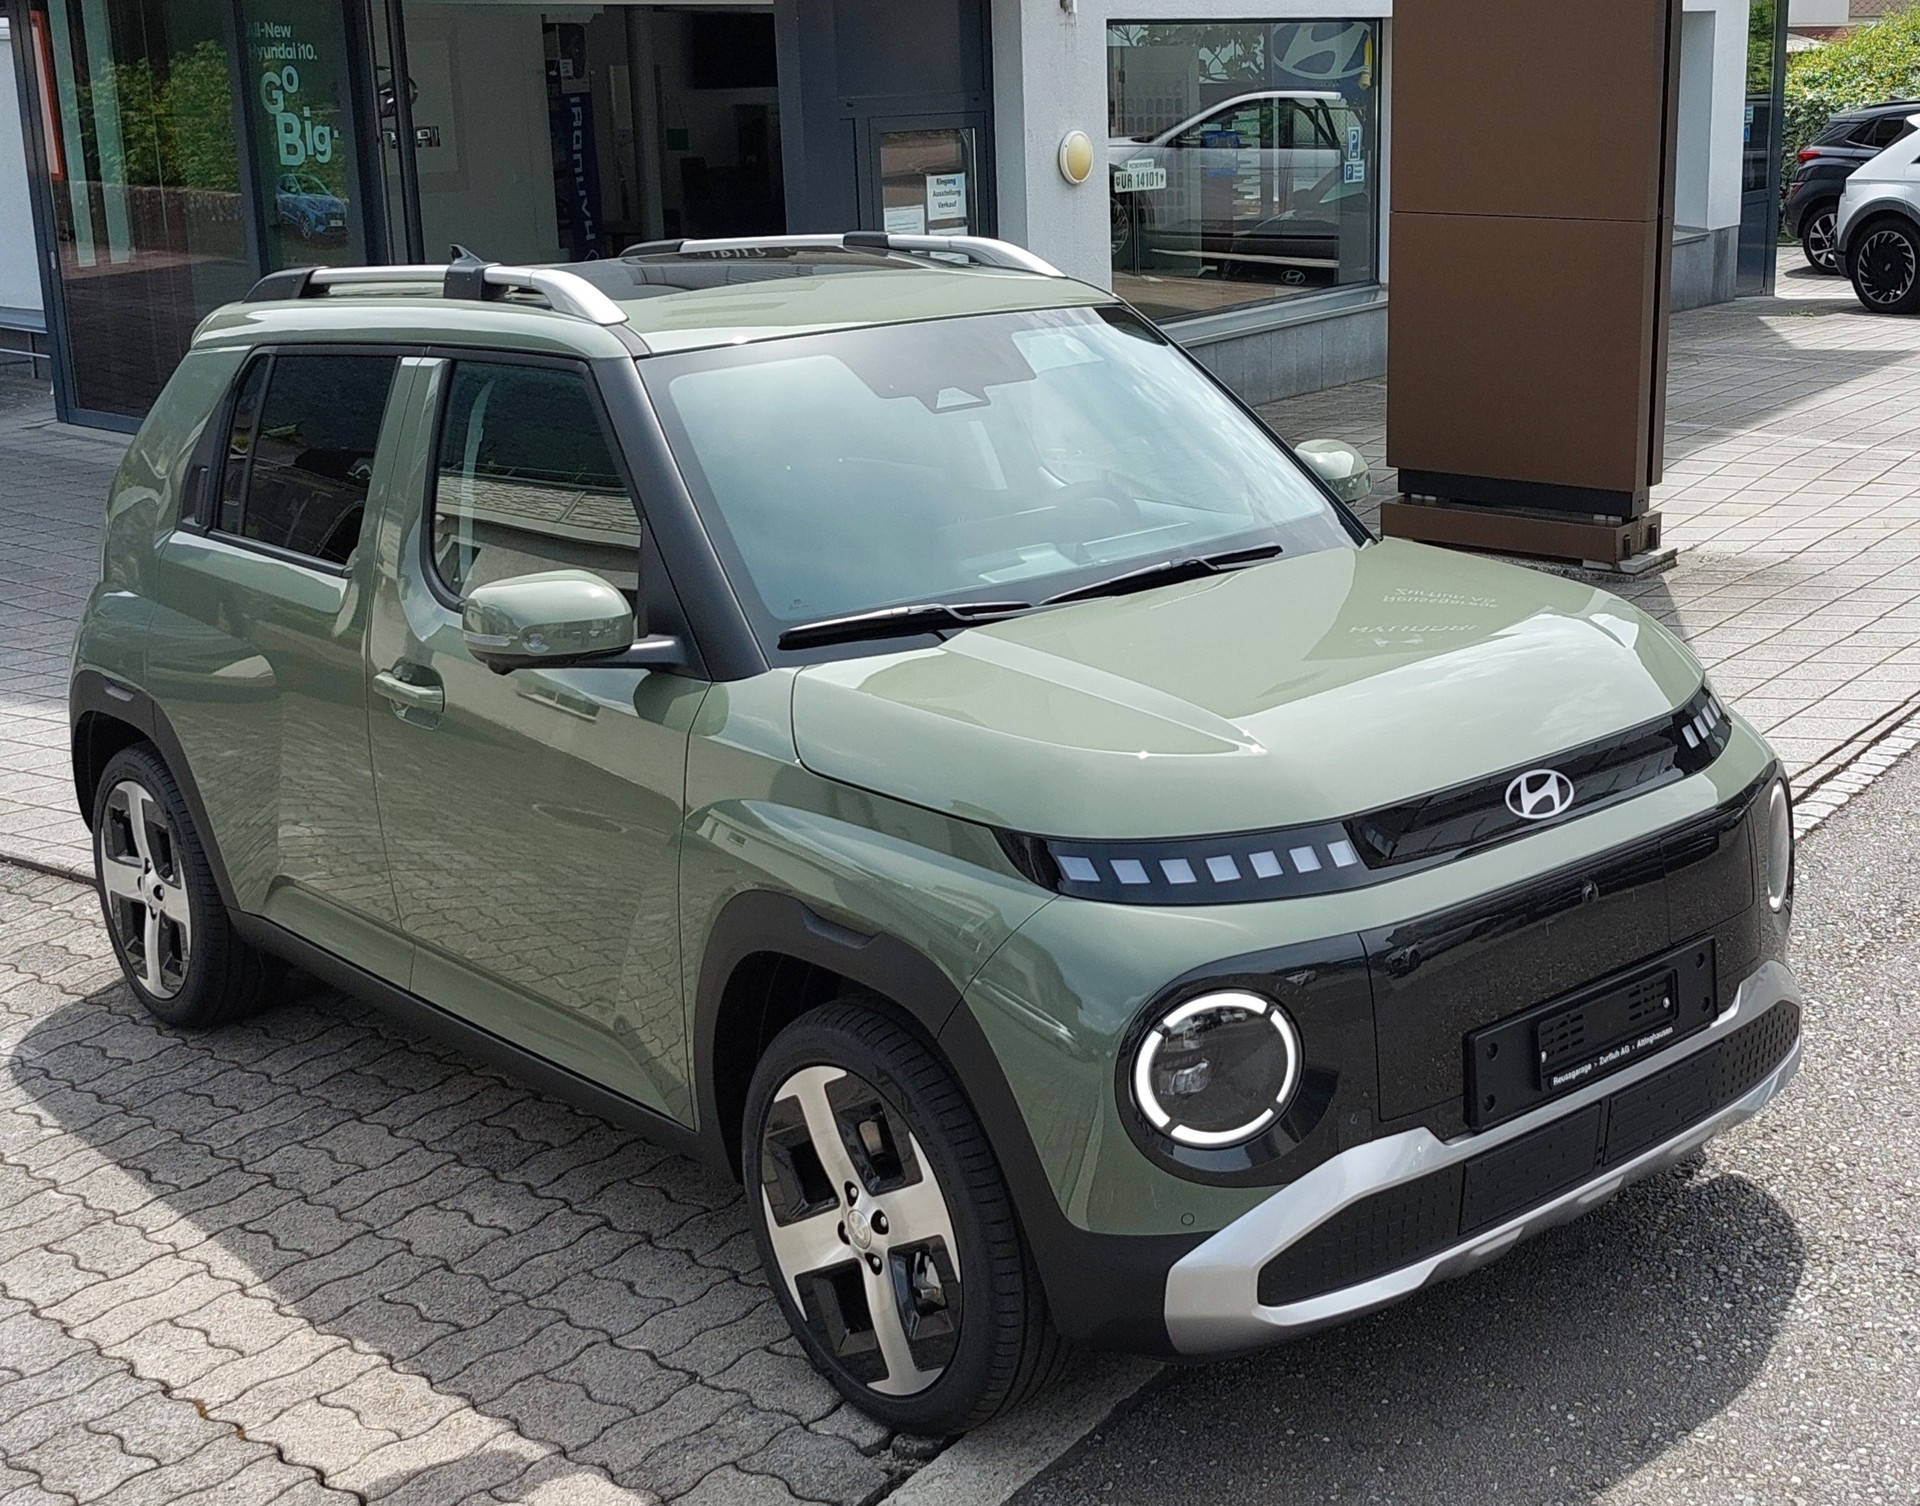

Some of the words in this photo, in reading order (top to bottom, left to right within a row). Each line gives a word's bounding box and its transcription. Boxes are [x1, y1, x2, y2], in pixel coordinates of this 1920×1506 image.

[298, 43, 318, 60] i10.
[259, 65, 299, 115] Go
[936, 178, 957, 186] Eingang
[1121, 173, 1133, 189] UR
[1136, 171, 1159, 188] 14101
[932, 189, 962, 198] Ausstellung
[937, 200, 957, 209] Verkauf
[1553, 1063, 1592, 1086] Reussgarage
[1599, 1049, 1620, 1066] Zurfluh
[1620, 1045, 1630, 1056] AG
[1637, 1026, 1673, 1049] Attinghausen
